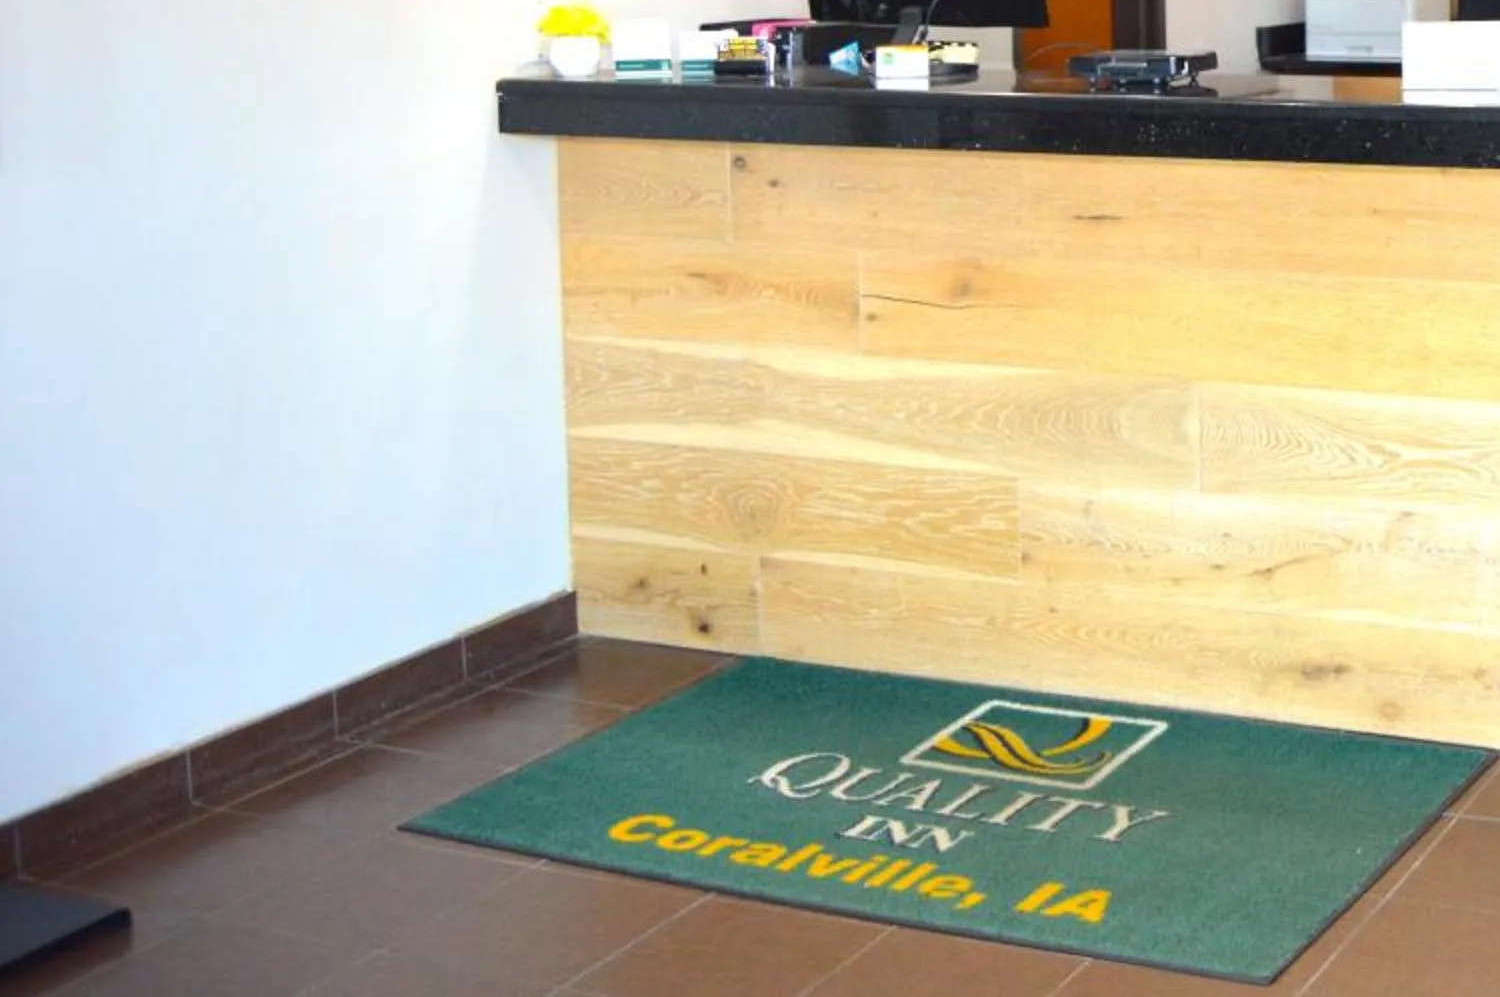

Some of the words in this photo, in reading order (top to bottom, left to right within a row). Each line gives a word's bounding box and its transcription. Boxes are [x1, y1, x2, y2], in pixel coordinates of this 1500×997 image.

[747, 751, 1171, 843] QUALITY
[836, 814, 976, 853] INN
[607, 814, 988, 910] Coralville,
[1012, 881, 1113, 923] IA
